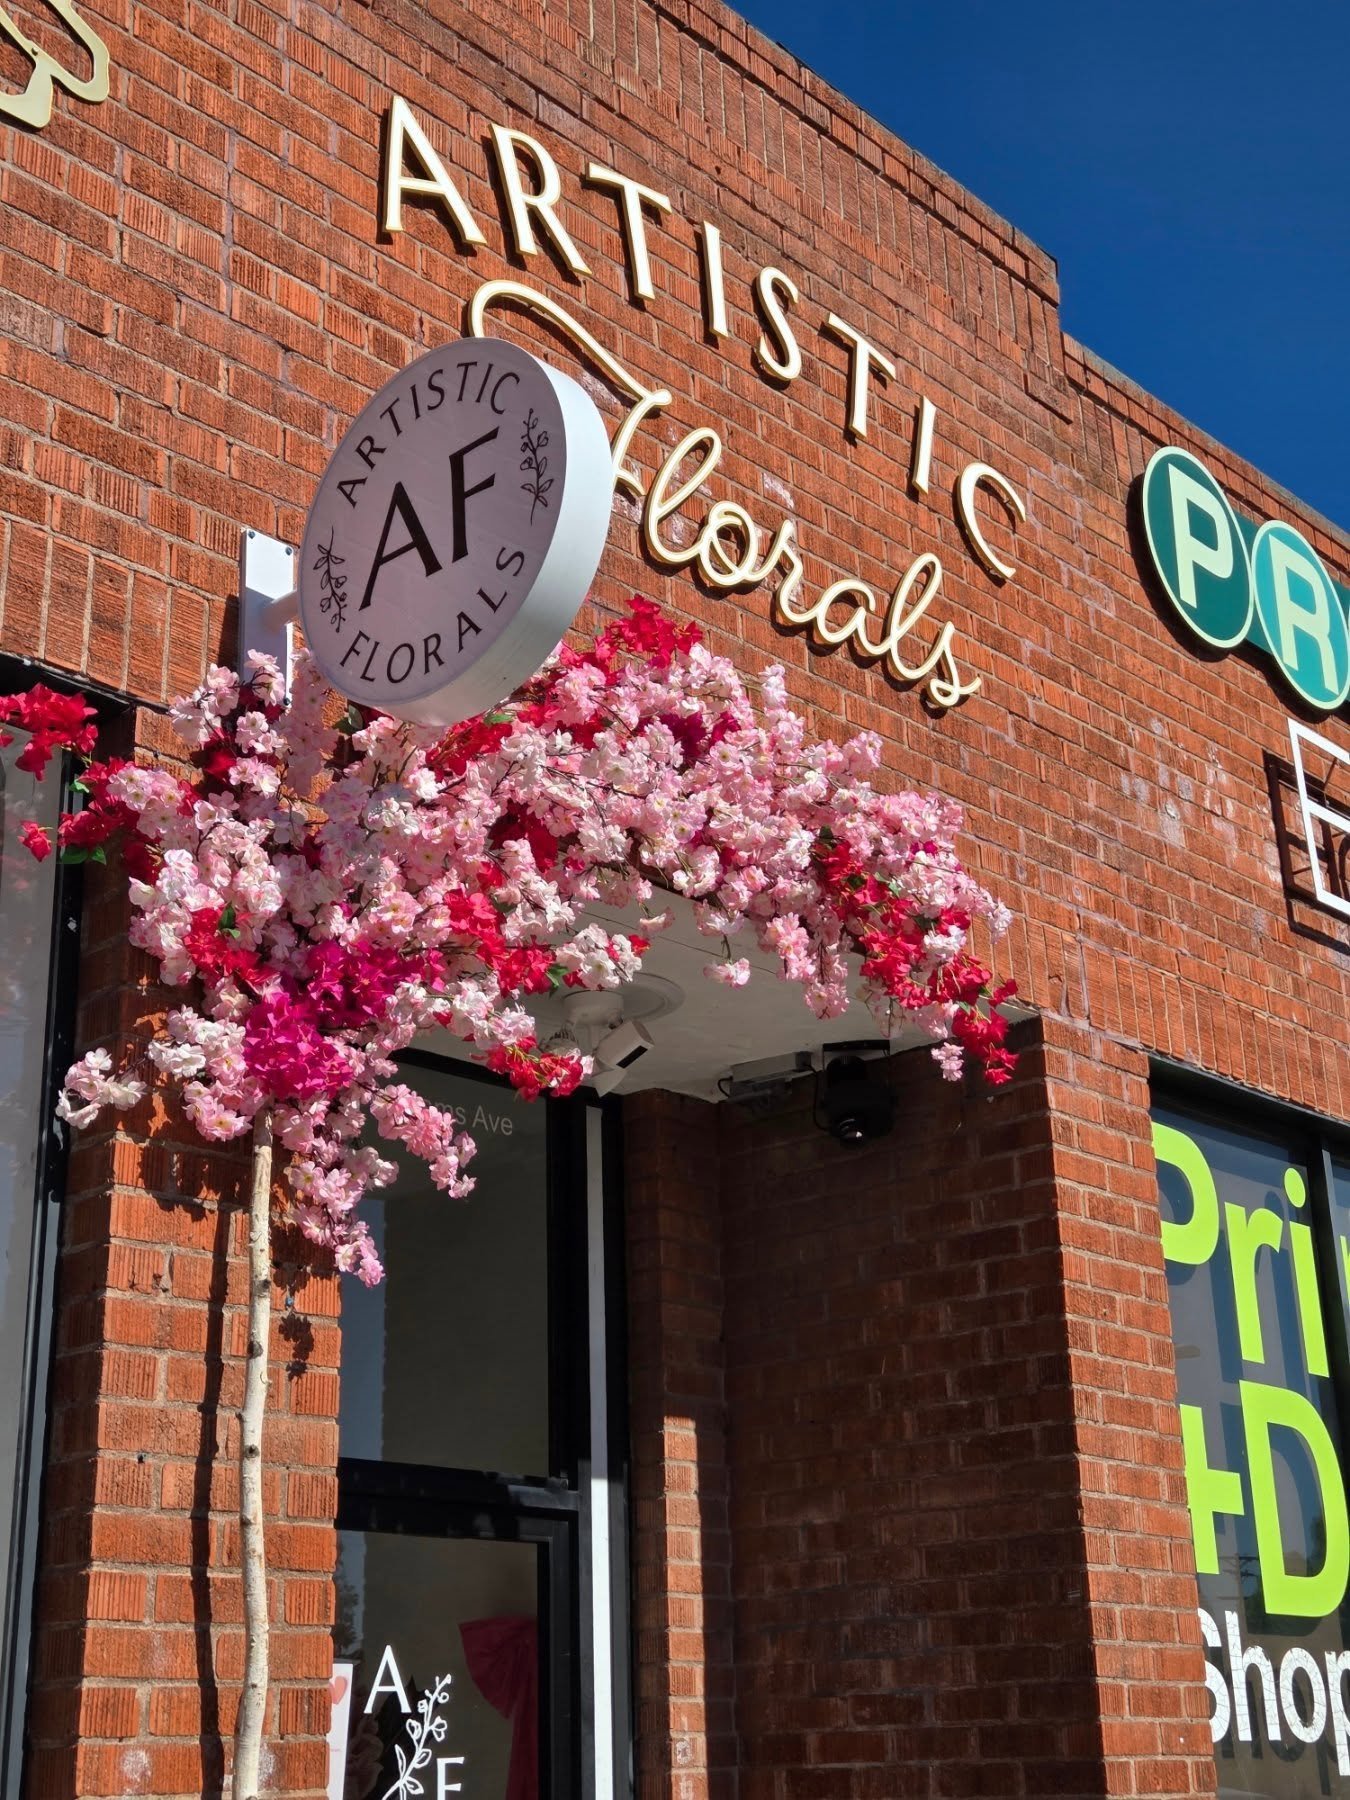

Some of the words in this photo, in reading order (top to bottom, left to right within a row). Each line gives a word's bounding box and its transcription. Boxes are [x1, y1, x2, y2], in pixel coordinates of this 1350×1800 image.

[385, 95, 1026, 579] ARTISTIC
[336, 361, 520, 508] ARTISTIC
[358, 426, 500, 611] AF
[339, 547, 525, 684] FLORALS
[472, 1105, 513, 1136] Ave
[1151, 1121, 1350, 1378] Pri
[363, 1645, 412, 1714] A
